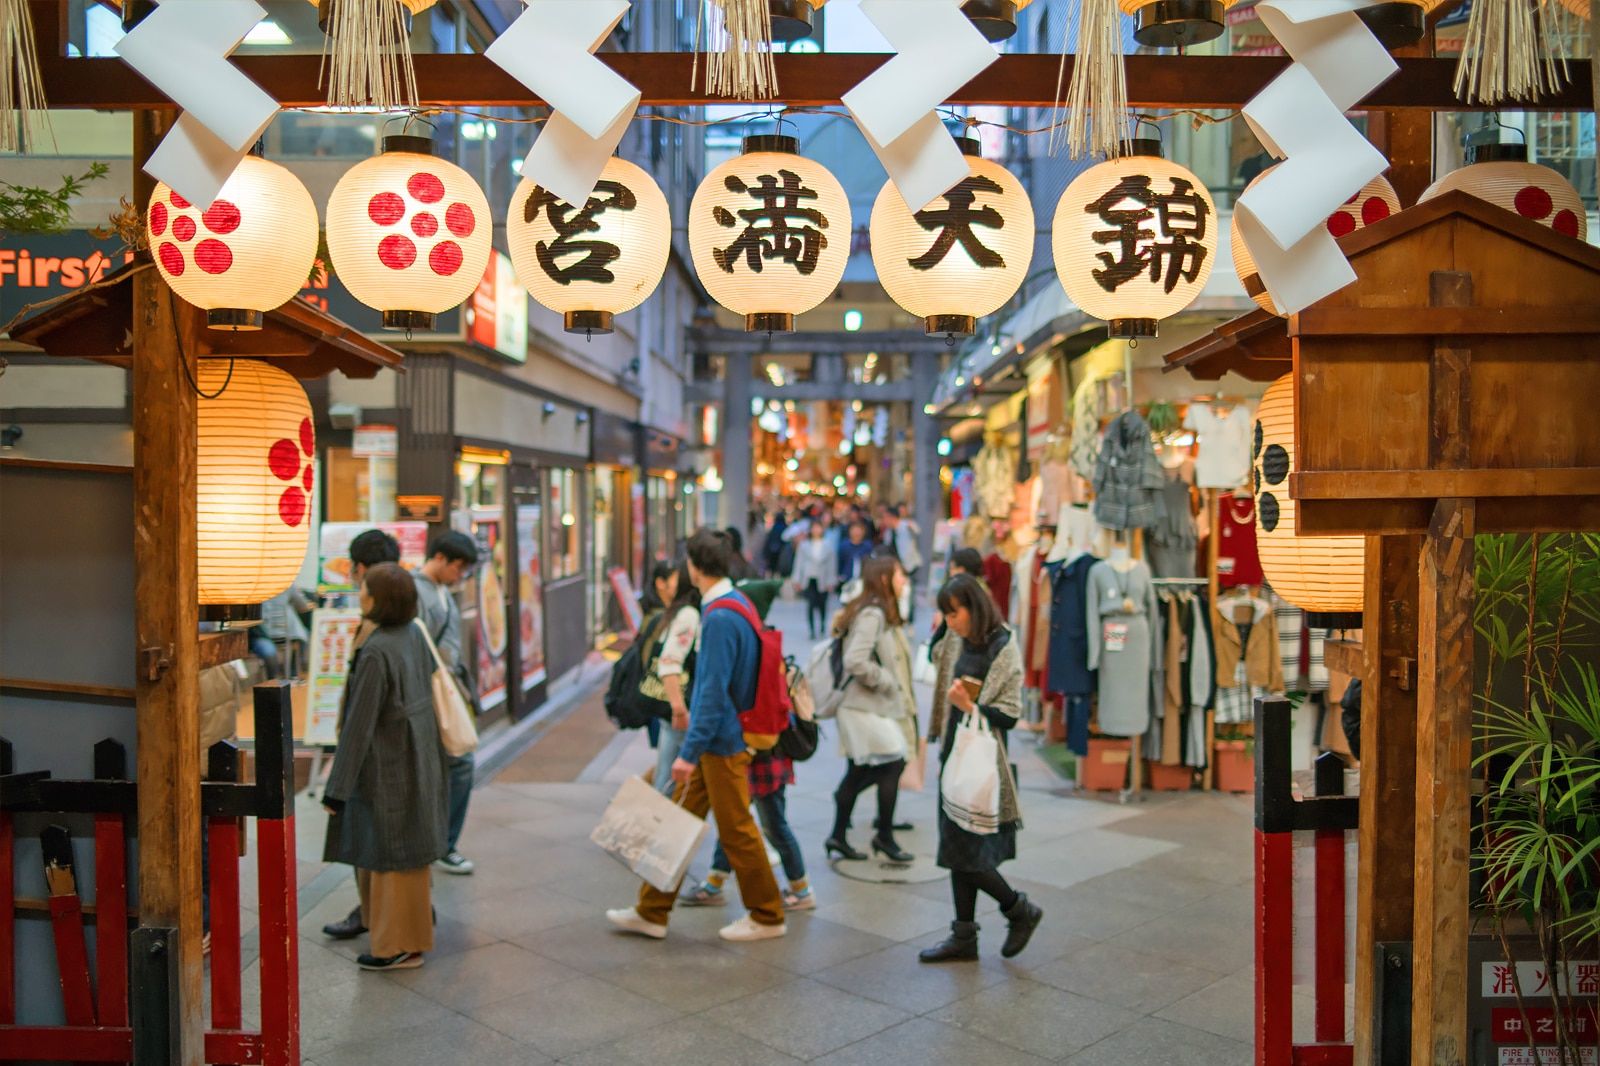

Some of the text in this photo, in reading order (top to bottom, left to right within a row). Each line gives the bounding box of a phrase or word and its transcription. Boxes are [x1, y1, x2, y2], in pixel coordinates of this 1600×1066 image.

[0, 248, 112, 288] First
[524, 180, 637, 286] 宮
[712, 169, 829, 275] 満
[907, 175, 1006, 271] 天
[1084, 175, 1210, 294] 錦
[1502, 1049, 1523, 1057] FIRE
